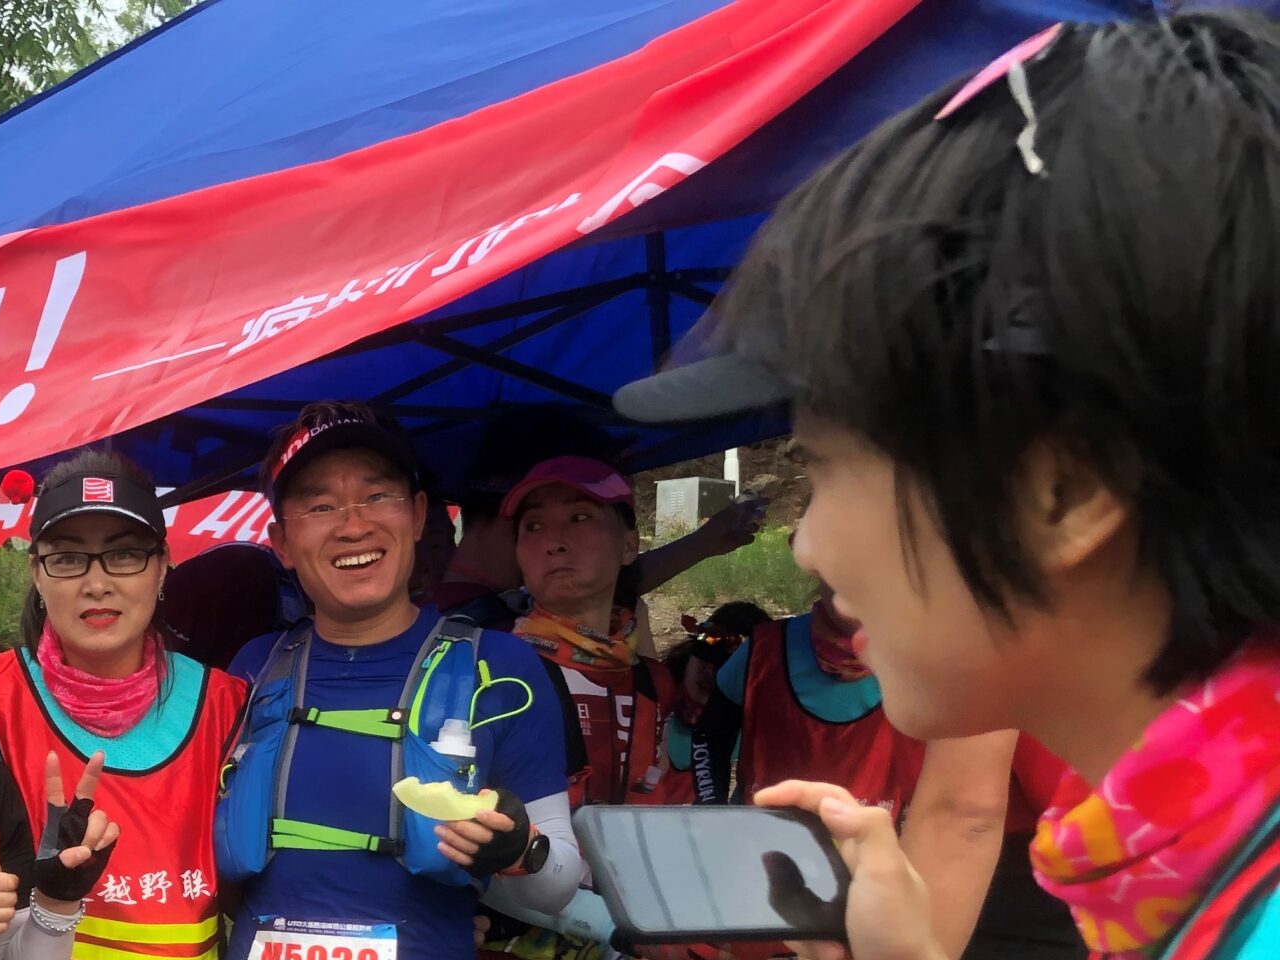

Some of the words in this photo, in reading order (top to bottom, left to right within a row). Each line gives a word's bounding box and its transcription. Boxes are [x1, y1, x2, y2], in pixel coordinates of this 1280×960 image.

[692, 742, 716, 801] JOYRUN
[82, 868, 210, 905] 越野联
